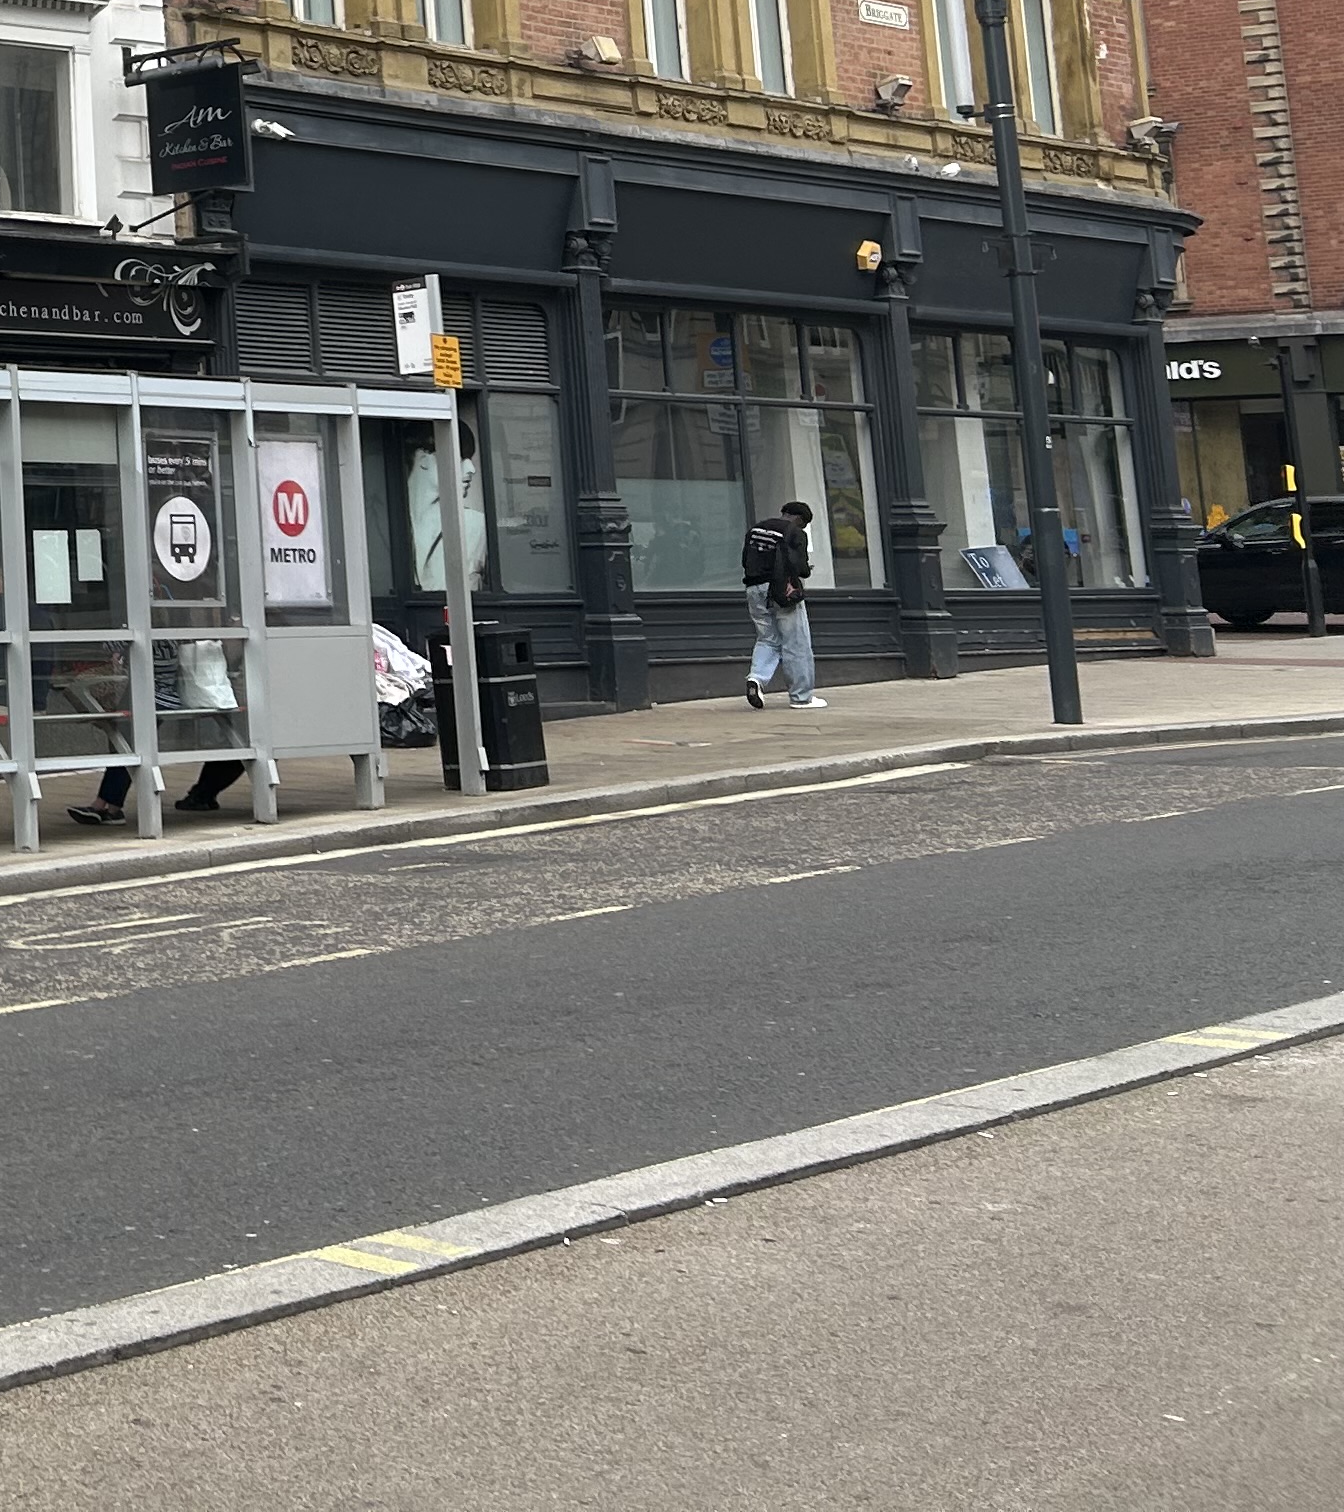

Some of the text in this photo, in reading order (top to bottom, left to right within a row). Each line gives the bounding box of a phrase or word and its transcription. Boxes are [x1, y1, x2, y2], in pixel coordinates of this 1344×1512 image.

[864, 3, 904, 24] BRIGGATE
[159, 137, 198, 159] Kitchen
[209, 133, 234, 151] Bar
[277, 492, 305, 526] M
[270, 547, 317, 564] METRO
[967, 552, 991, 569] To
[981, 572, 1008, 588] Let
